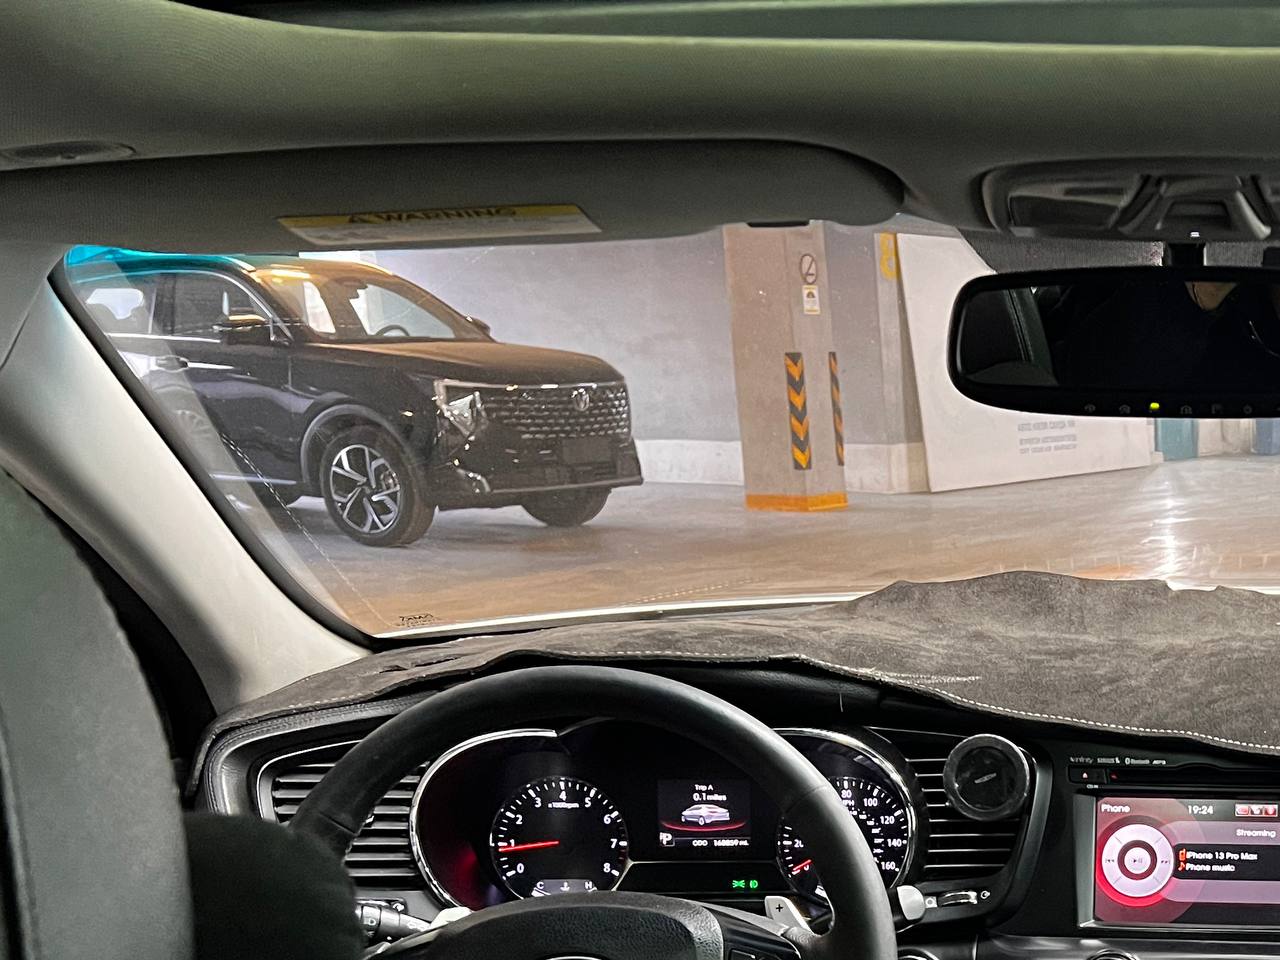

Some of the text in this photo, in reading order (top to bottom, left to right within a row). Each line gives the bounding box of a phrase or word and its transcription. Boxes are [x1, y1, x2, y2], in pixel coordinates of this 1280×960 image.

[377, 206, 517, 222] WARNING
[559, 790, 567, 801] 4
[841, 789, 852, 799] 80
[534, 796, 542, 808] 3
[584, 796, 592, 808] 5
[863, 797, 878, 807] 100
[1101, 803, 1131, 813] Phone
[1187, 805, 1214, 815] 19:24
[515, 814, 523, 825] 2
[603, 814, 611, 825] 6
[880, 815, 895, 825] 120
[1236, 828, 1277, 839] Streaming
[610, 838, 618, 849] 7
[887, 838, 902, 848] 140
[1215, 851, 1225, 860] 13
[1226, 851, 1239, 860] Pro
[1240, 852, 1258, 860] Max
[516, 862, 525, 874] 0
[603, 862, 611, 873] 8
[881, 861, 896, 870] 160
[1212, 863, 1236, 872] music
[536, 881, 544, 890] C
[584, 881, 593, 889] H
